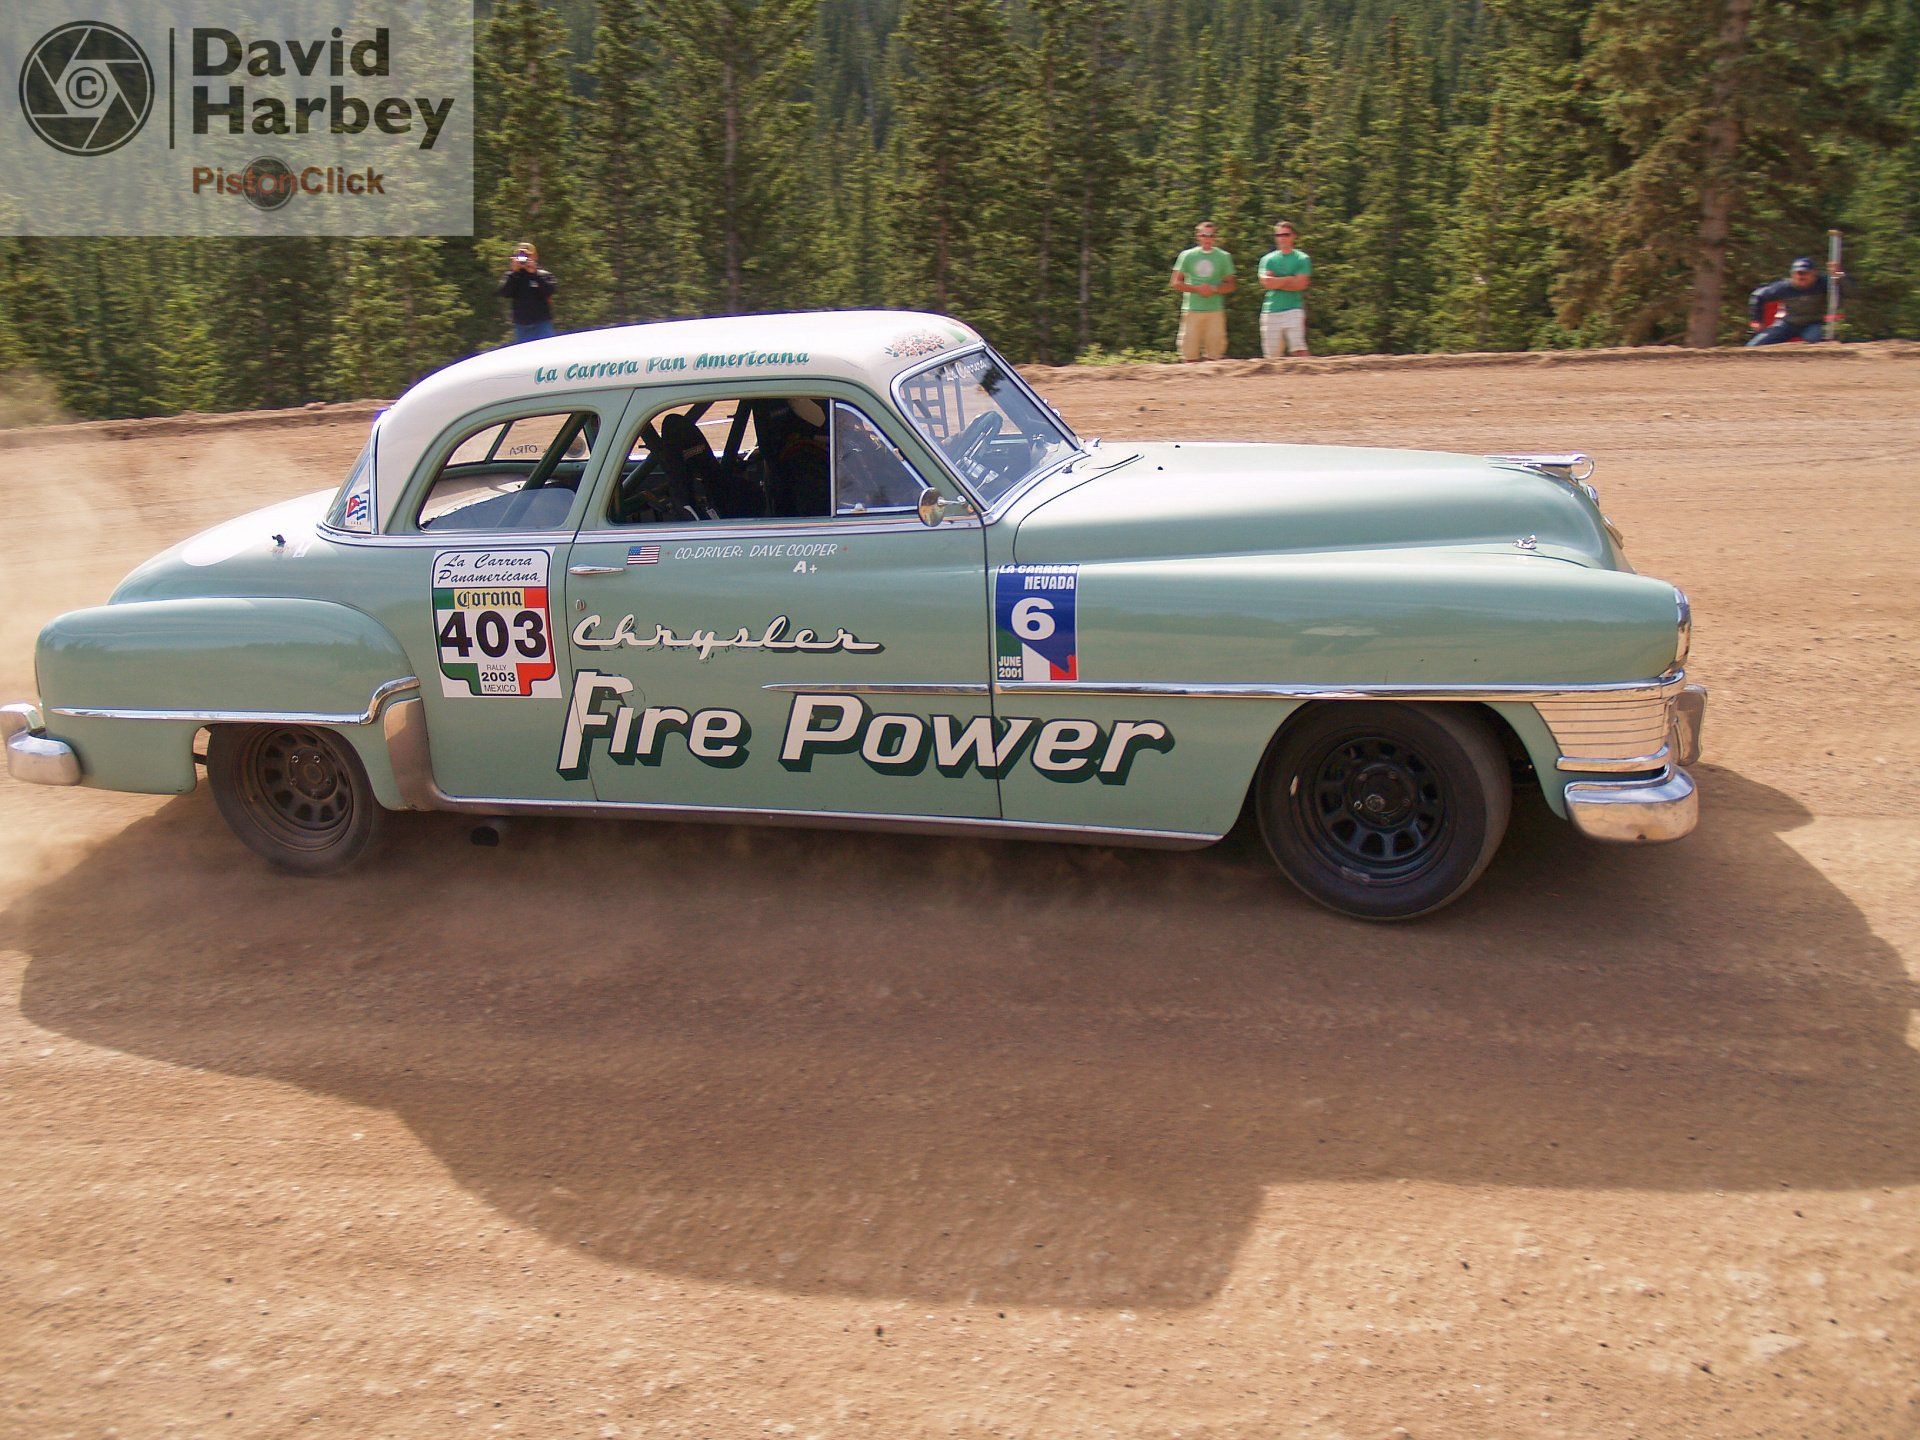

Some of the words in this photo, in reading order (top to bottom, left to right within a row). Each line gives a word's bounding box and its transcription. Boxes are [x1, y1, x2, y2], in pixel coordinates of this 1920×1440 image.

[535, 366, 558, 384] La
[565, 358, 639, 381] Carrera
[647, 355, 687, 374] Pan
[693, 350, 811, 370] Americana
[675, 545, 743, 560] CO-DRIVER:
[749, 544, 786, 558] DAVE
[786, 543, 838, 557] COOPER
[444, 555, 466, 568] La
[474, 553, 533, 569] Carrera
[999, 564, 1016, 574] LA
[1017, 564, 1079, 574] CARRERA
[438, 569, 539, 585] Panamericana
[1024, 576, 1075, 590] NEVADA
[457, 590, 523, 609] Corona
[1011, 596, 1056, 641] 6
[440, 610, 547, 659] 403
[572, 613, 885, 660] Chrysler
[998, 656, 1022, 667] JUNE
[481, 672, 516, 682] 2003
[998, 667, 1022, 678] 2001
[484, 684, 517, 693] MEXICO
[556, 669, 752, 782] Fire
[778, 692, 1175, 786] Power
